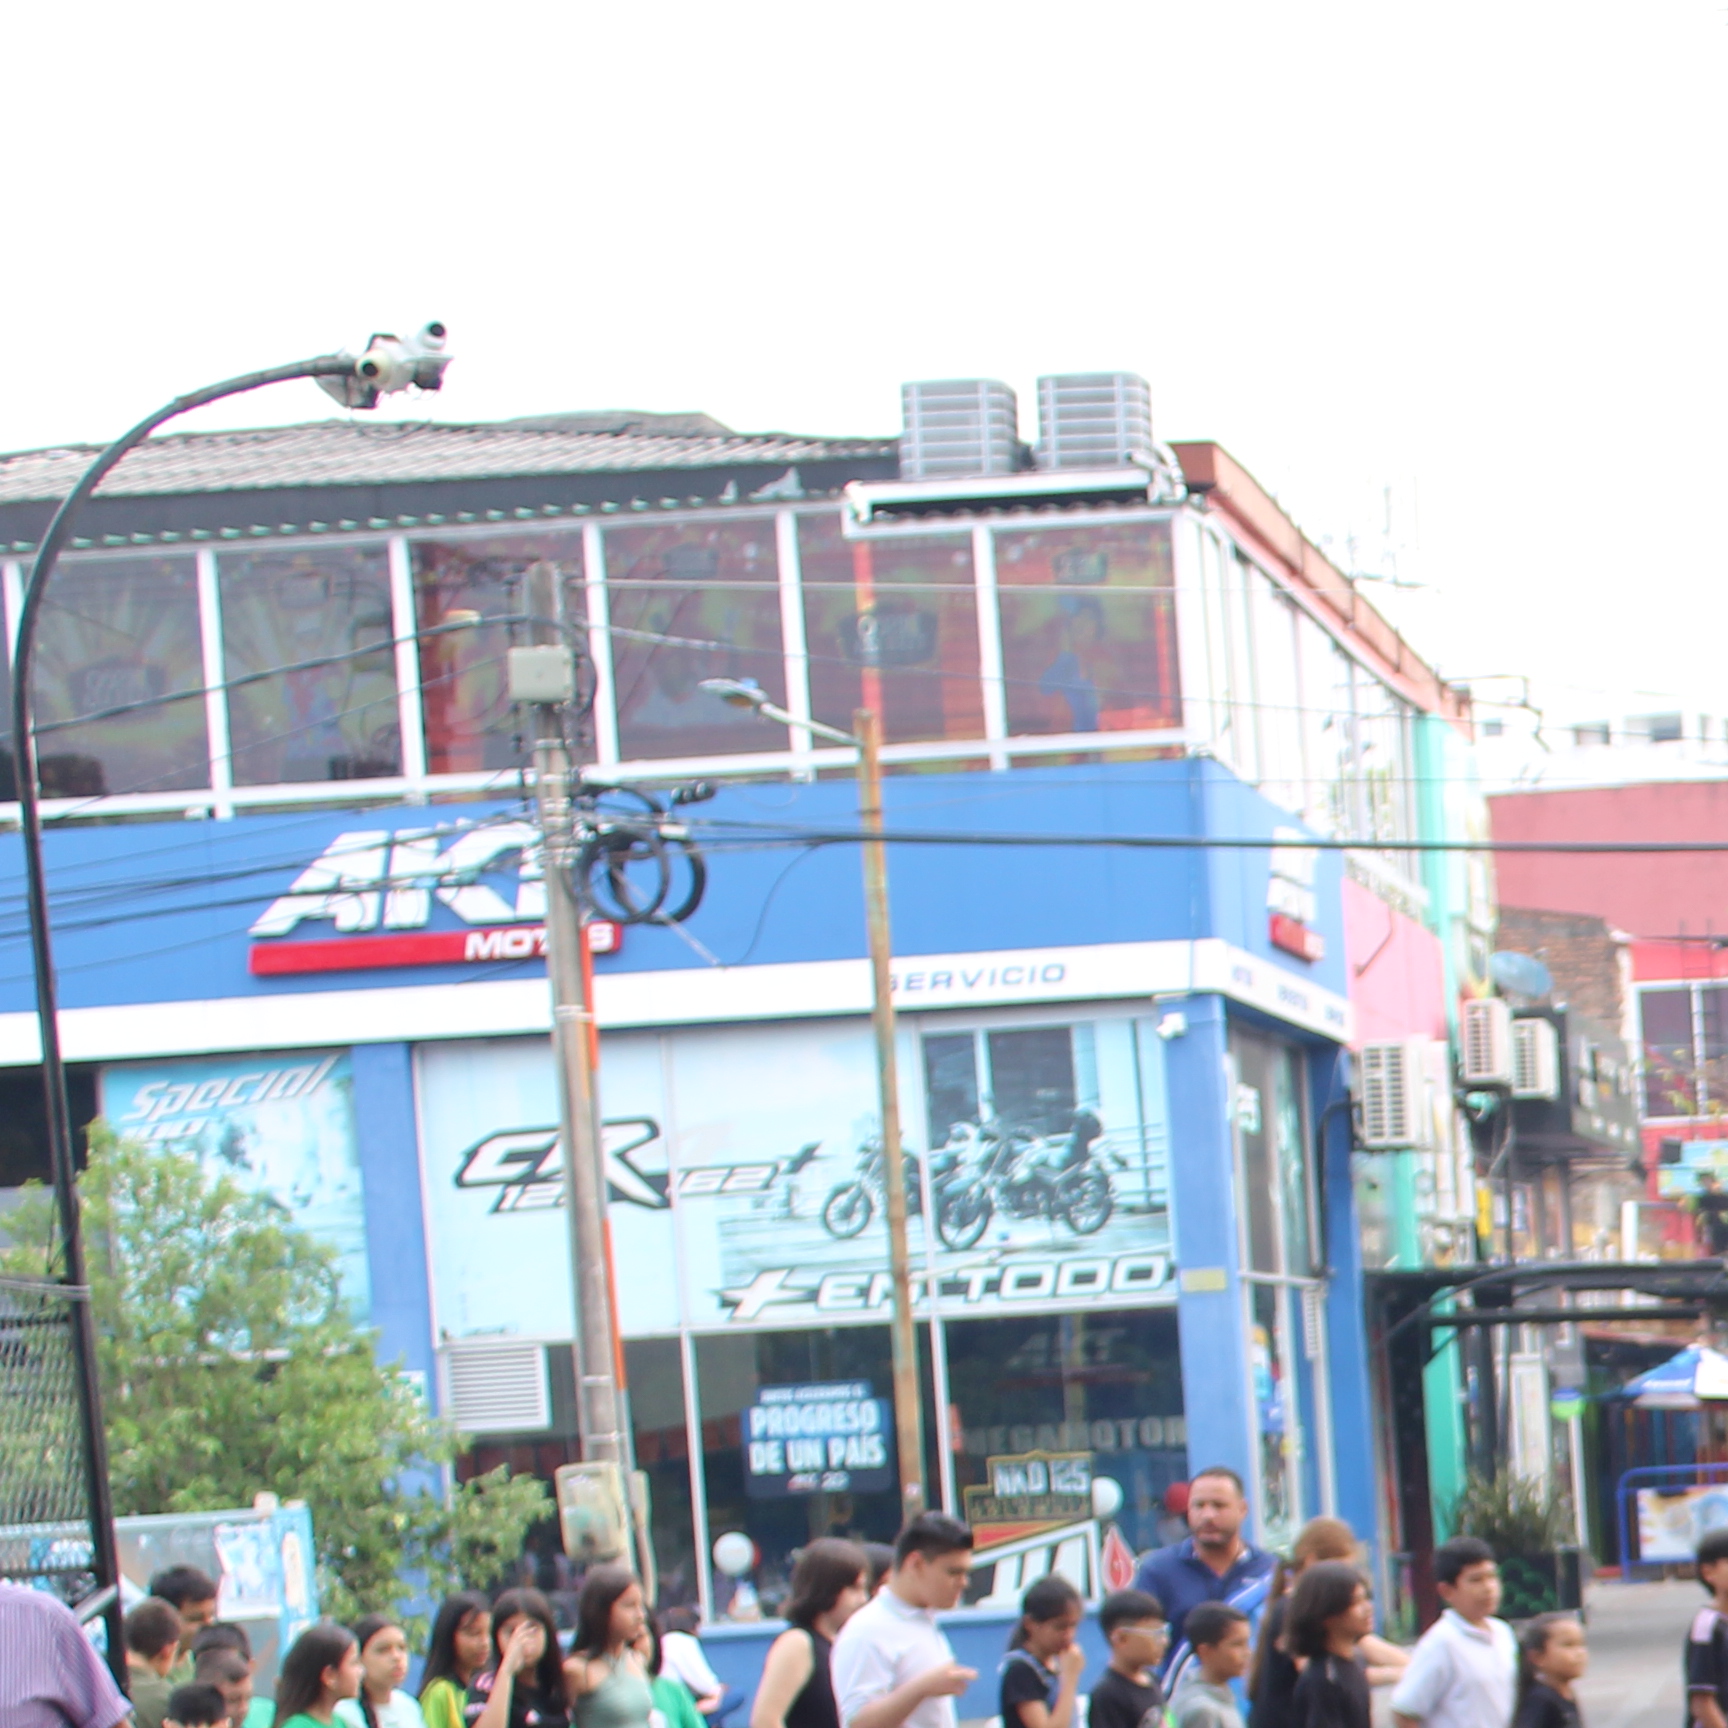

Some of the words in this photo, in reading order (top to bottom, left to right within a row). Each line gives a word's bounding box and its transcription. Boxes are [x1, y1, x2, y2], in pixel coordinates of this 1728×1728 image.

[465, 922, 616, 961] MOTS
[120, 1054, 341, 1122] Special
[490, 1182, 566, 1212] 12
[951, 1253, 1170, 1303] TODO
[749, 1399, 880, 1440] PROGRESO
[749, 1438, 786, 1475] DE
[786, 1436, 825, 1474] UN
[827, 1430, 887, 1470] PAÍS
[1050, 1458, 1092, 1495] 125
